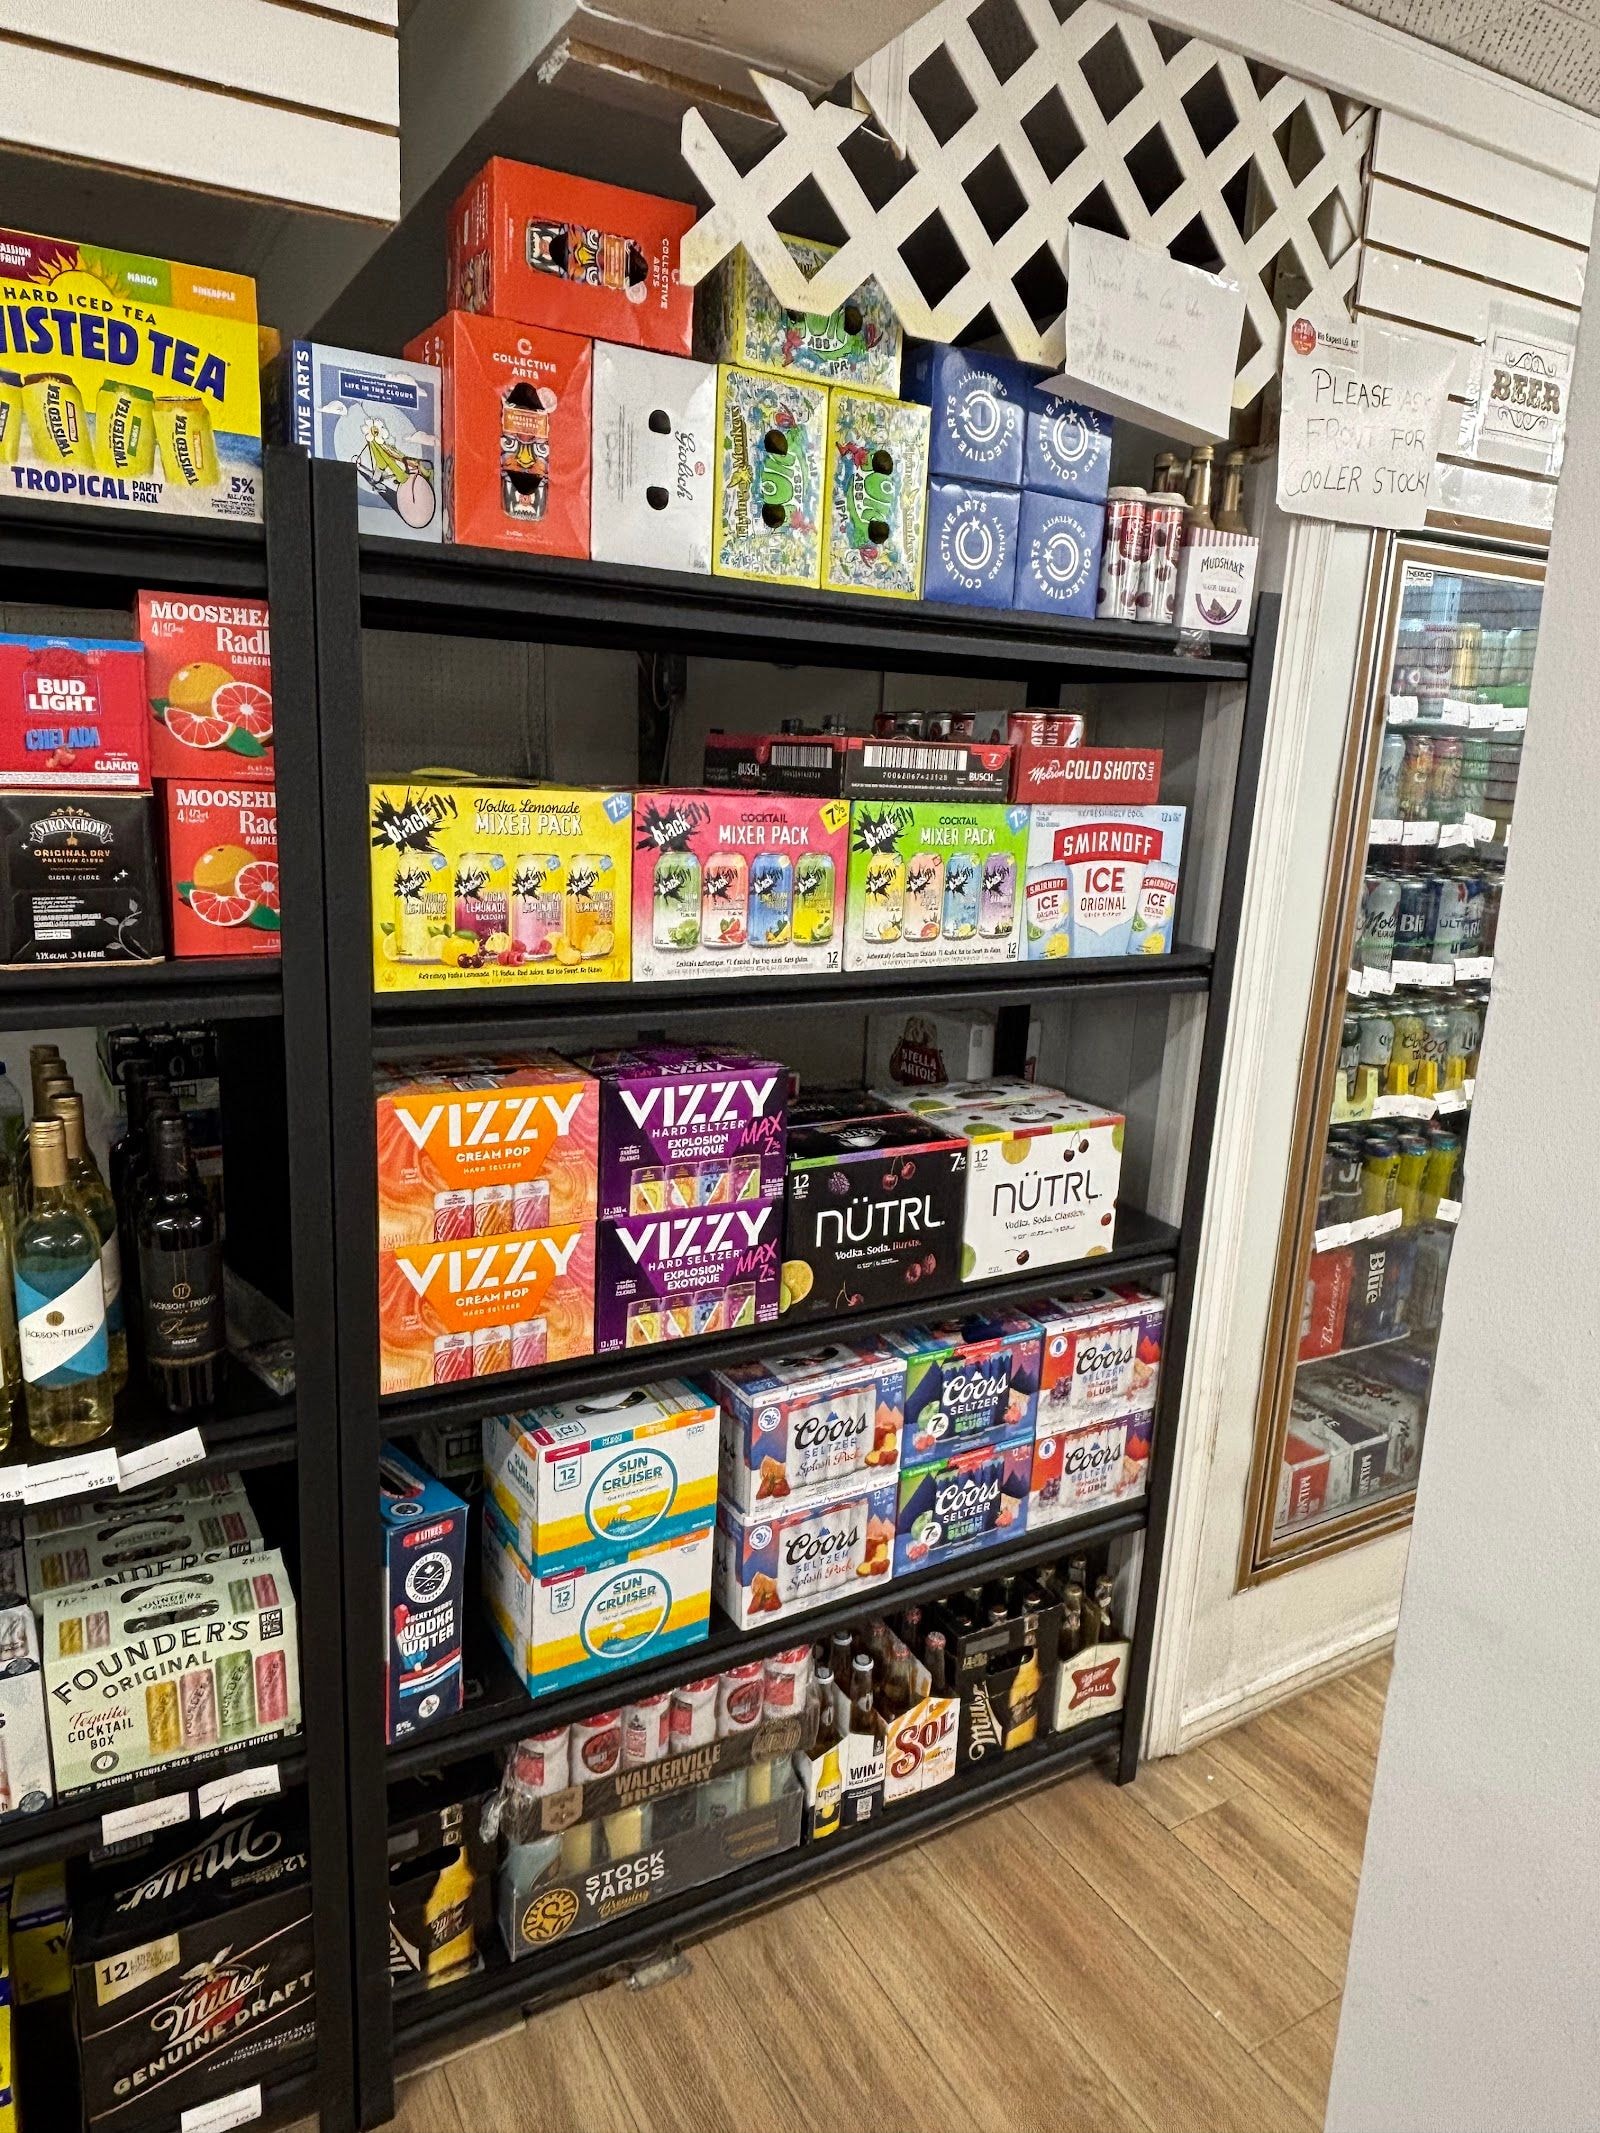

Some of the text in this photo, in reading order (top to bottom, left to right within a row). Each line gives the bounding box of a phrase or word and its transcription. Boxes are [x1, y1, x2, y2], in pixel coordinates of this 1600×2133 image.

[0, 252, 26, 267] FRUIT
[127, 272, 158, 287] MANGO
[651, 255, 661, 289] ARTS
[660, 236, 670, 311] COLLECTIVE
[4, 286, 157, 326] HARD ICED TEA
[0, 304, 226, 402] ISTED TEA
[492, 352, 557, 374] COLLECTIVE
[297, 350, 311, 401] ARTS
[511, 365, 540, 381] ARTS
[829, 360, 849, 376] IPA
[344, 381, 414, 400] LIFE CLOUDS
[1312, 368, 1394, 408] PLEASE
[1490, 368, 1561, 415] BEER
[111, 420, 128, 469] TWISTED
[958, 406, 1015, 463] COLLECTIVE
[1391, 427, 1426, 451] FOR
[674, 431, 698, 502] Grolsch
[11, 465, 163, 501] TROPICAL PARTY
[231, 476, 255, 495] 5%
[1286, 464, 1361, 497] COOLER
[133, 491, 159, 504] PACK
[940, 499, 988, 590] COLLECTIVE ARTS
[1039, 547, 1092, 601] COLLECTIVE
[1201, 555, 1246, 579] MUDSHAKE
[37, 677, 87, 697] BUD
[28, 694, 98, 712] LIGHT
[26, 726, 101, 751] CHELADA
[94, 758, 140, 773] CLAMATO
[737, 762, 762, 777] BUSCH
[968, 772, 994, 783] BUSCH
[1065, 759, 1101, 781] COLD
[1103, 759, 1148, 782] SHOTS
[474, 797, 582, 815] Vodka Lemonade
[740, 812, 789, 824] COCKTAIL
[34, 816, 106, 836] STRONGBOW
[474, 812, 584, 837] MIXER PACK
[939, 816, 979, 826] COCKTAIL
[718, 824, 810, 846] MIXER PACK
[920, 826, 996, 846] MIXER PACK
[1063, 830, 1154, 858] SMIRNOFF
[33, 849, 111, 858] ORIGINAL DRY
[1029, 878, 1066, 895] SMIRNOFF
[1084, 866, 1126, 894] ICE
[1143, 878, 1176, 893] SMIRNOFF
[1036, 894, 1059, 911] ICE
[1080, 895, 1127, 912] ORIGINAL
[1145, 892, 1167, 908] ICE
[826, 950, 840, 964] 12
[901, 1049, 938, 1070] STELLA
[900, 1063, 938, 1084] ARTOIS
[618, 1077, 778, 1130] VIZZY
[395, 1092, 585, 1151] VIZZY
[652, 1119, 746, 1140] HARD SELTZER
[739, 1110, 783, 1148] MAX
[667, 1133, 730, 1150] EXPLOSION
[671, 1144, 725, 1160] EXOTIQUE
[455, 1145, 531, 1164] CREAM POP
[974, 1148, 989, 1163] 12
[463, 1161, 523, 1175] HARD SELTZER
[793, 1173, 810, 1188] 12
[1004, 1215, 1054, 1231] Vodka. Soda.
[615, 1206, 773, 1265] VIZZY
[648, 1249, 742, 1273] HARD SELTZER
[735, 1237, 778, 1278] MAX
[834, 1243, 892, 1261] Vodka. Soda.
[396, 1232, 582, 1297] VIZZY
[663, 1263, 726, 1283] EXPLOSION
[666, 1273, 721, 1292] EXOTIQUE
[455, 1286, 530, 1308] CREAM POP
[1319, 1261, 1343, 1350] Budweiser
[462, 1308, 485, 1318] HARD
[1076, 1344, 1135, 1375] Coors
[942, 1372, 1010, 1406] Coors
[950, 1396, 1000, 1416] SELTZER
[793, 1411, 868, 1450] Coors
[805, 1437, 858, 1459] SELTZER
[1064, 1441, 1122, 1476] Coors
[561, 1467, 576, 1482] 12
[617, 1455, 649, 1473] SUN
[797, 1456, 831, 1478] Splash
[602, 1466, 665, 1493] CRUISER
[934, 1478, 1001, 1516] Coors
[942, 1501, 991, 1524] SELTZER
[786, 1527, 860, 1566] Coors
[795, 1550, 850, 1574] SELTZER
[612, 1575, 643, 1596] SUN
[786, 1568, 823, 1592] Splash
[555, 1589, 571, 1605] 12
[596, 1584, 658, 1612] CRUISER
[404, 1608, 454, 1640] VODKA
[402, 1624, 454, 1657] WATER
[51, 1619, 251, 1706] FOUNDER'S
[101, 1647, 215, 1700] ORIGINAL
[1077, 1683, 1110, 1699] HIGH LIFE
[68, 1703, 131, 1731] Tequila
[968, 1682, 998, 1762] Miller
[67, 1718, 136, 1745] COCKTAIL
[90, 1735, 116, 1753] BOX
[96, 1773, 134, 1790] PREMIUM
[223, 1740, 247, 1755] CRAFT
[614, 1745, 722, 1794] WALKERVILLE
[849, 1762, 877, 1781] WIN
[619, 1767, 713, 1808] BREWERY
[115, 1821, 283, 1913] Miller
[584, 1849, 666, 1893] STOCK
[584, 1866, 666, 1905] YARDS
[101, 1962, 130, 1986] 12
[150, 1963, 271, 2044] Miller
[113, 1969, 314, 2096] GENUINE DRAFT
